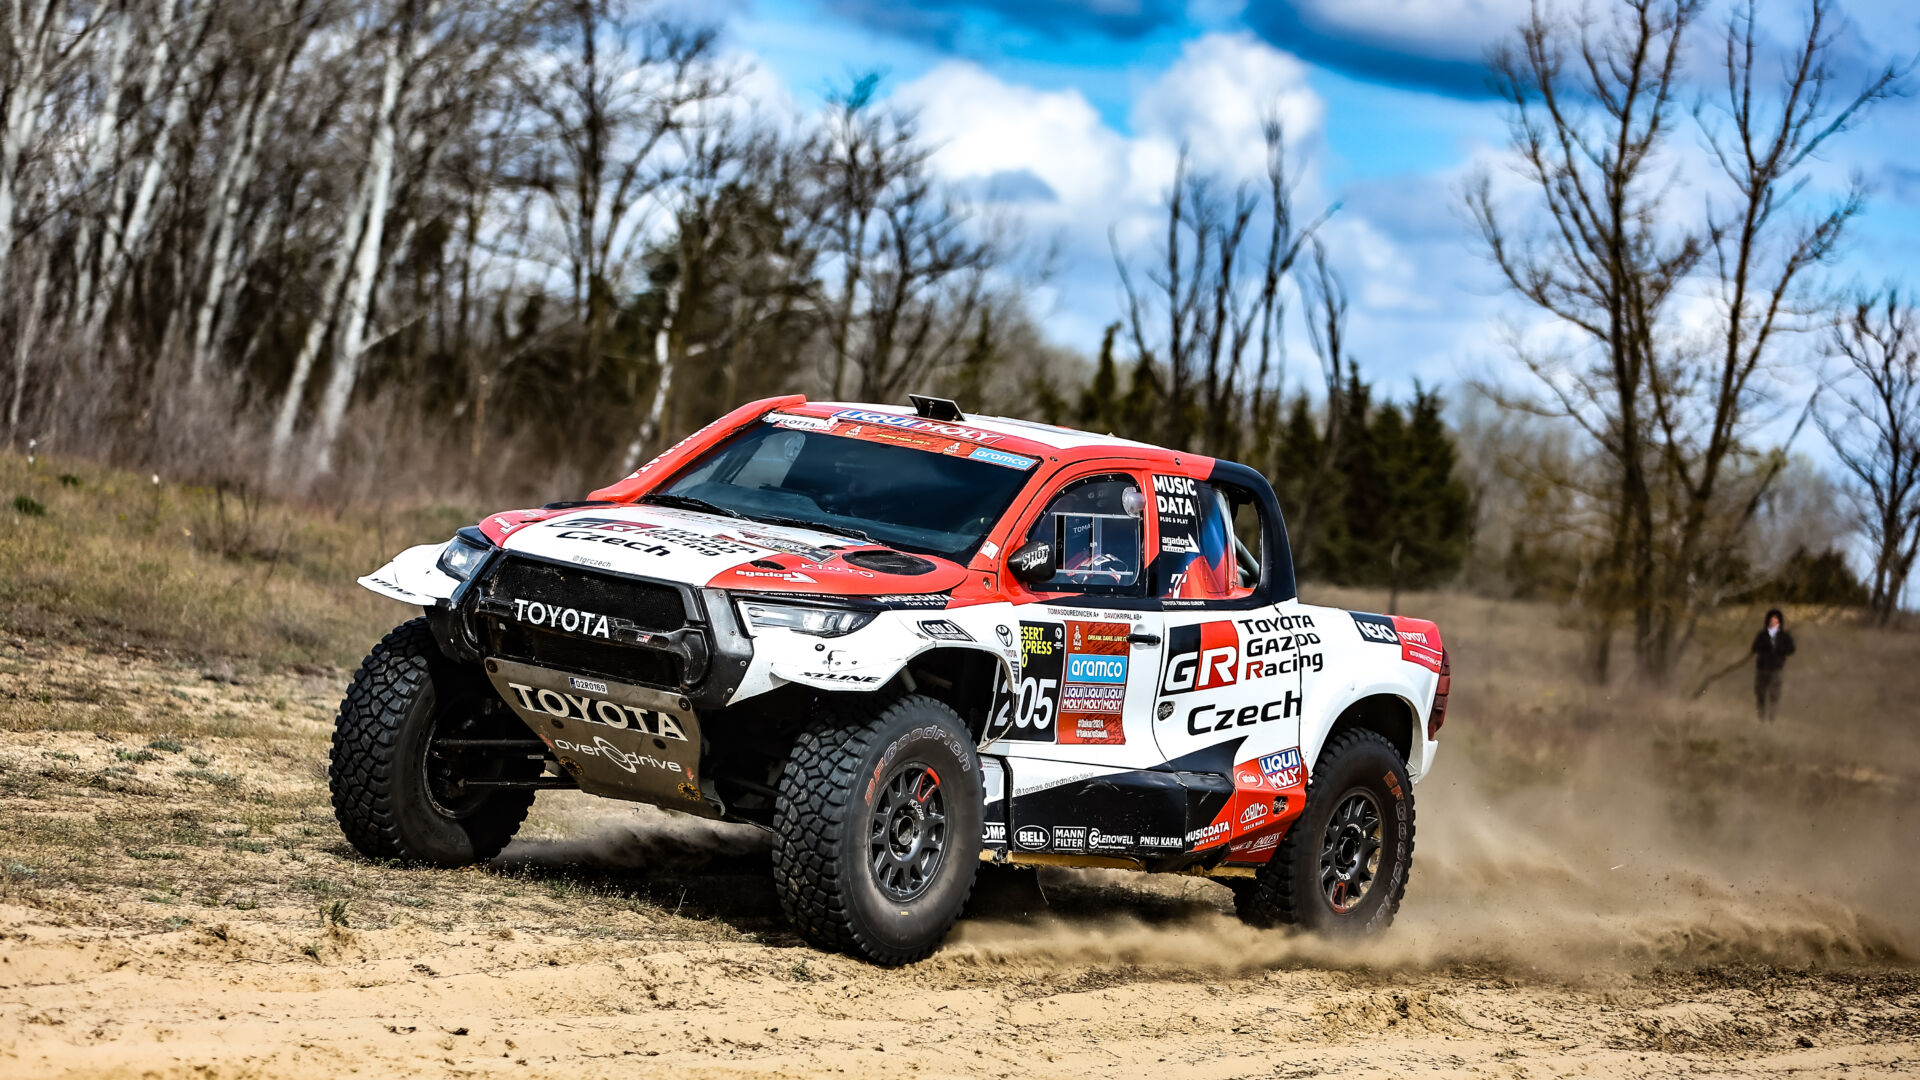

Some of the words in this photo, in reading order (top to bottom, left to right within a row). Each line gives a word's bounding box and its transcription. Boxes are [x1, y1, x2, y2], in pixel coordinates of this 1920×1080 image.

[839, 409, 917, 428] LIQUI
[915, 422, 999, 442] MOLY
[976, 451, 1029, 466] aramco
[1152, 475, 1197, 496] MUSIC
[1156, 495, 1196, 516] DATA
[556, 531, 672, 557] Czech
[634, 531, 721, 557] Racing
[667, 527, 759, 555] TOYOTA
[1162, 536, 1189, 546] agados
[573, 555, 612, 568] @tgrczech
[801, 563, 875, 578] KINTO
[736, 569, 792, 578] agados
[513, 598, 609, 638] TOYOTA
[1238, 615, 1315, 636] TOYOTA
[1020, 625, 1044, 641] ESERT
[1356, 621, 1398, 642] NEXO
[1397, 631, 1428, 644] TOYOTA
[1246, 632, 1321, 658] GAZOO
[1072, 660, 1122, 677] aramco
[1164, 646, 1238, 691] GR
[1245, 653, 1323, 680] Racing
[1065, 687, 1083, 698] LIQUI
[1084, 688, 1103, 699] LIQUI
[1105, 688, 1123, 699] LIQUI
[509, 683, 690, 741] TOYOTA
[1063, 699, 1081, 709] MOLY
[1083, 699, 1102, 710] MOLY
[1102, 700, 1121, 710] MOLY
[1187, 691, 1301, 736] Czech
[1261, 750, 1298, 774] LIQUI
[1268, 768, 1299, 789] MOLY
[1244, 802, 1265, 819] PRIM
[1019, 831, 1046, 843] BELL
[1055, 829, 1085, 838] MANN
[1140, 836, 1160, 846] PNEU
[1161, 837, 1183, 847] KAFKA
[1185, 821, 1230, 842] MUSICDATA
[1055, 838, 1084, 848] FILTER
